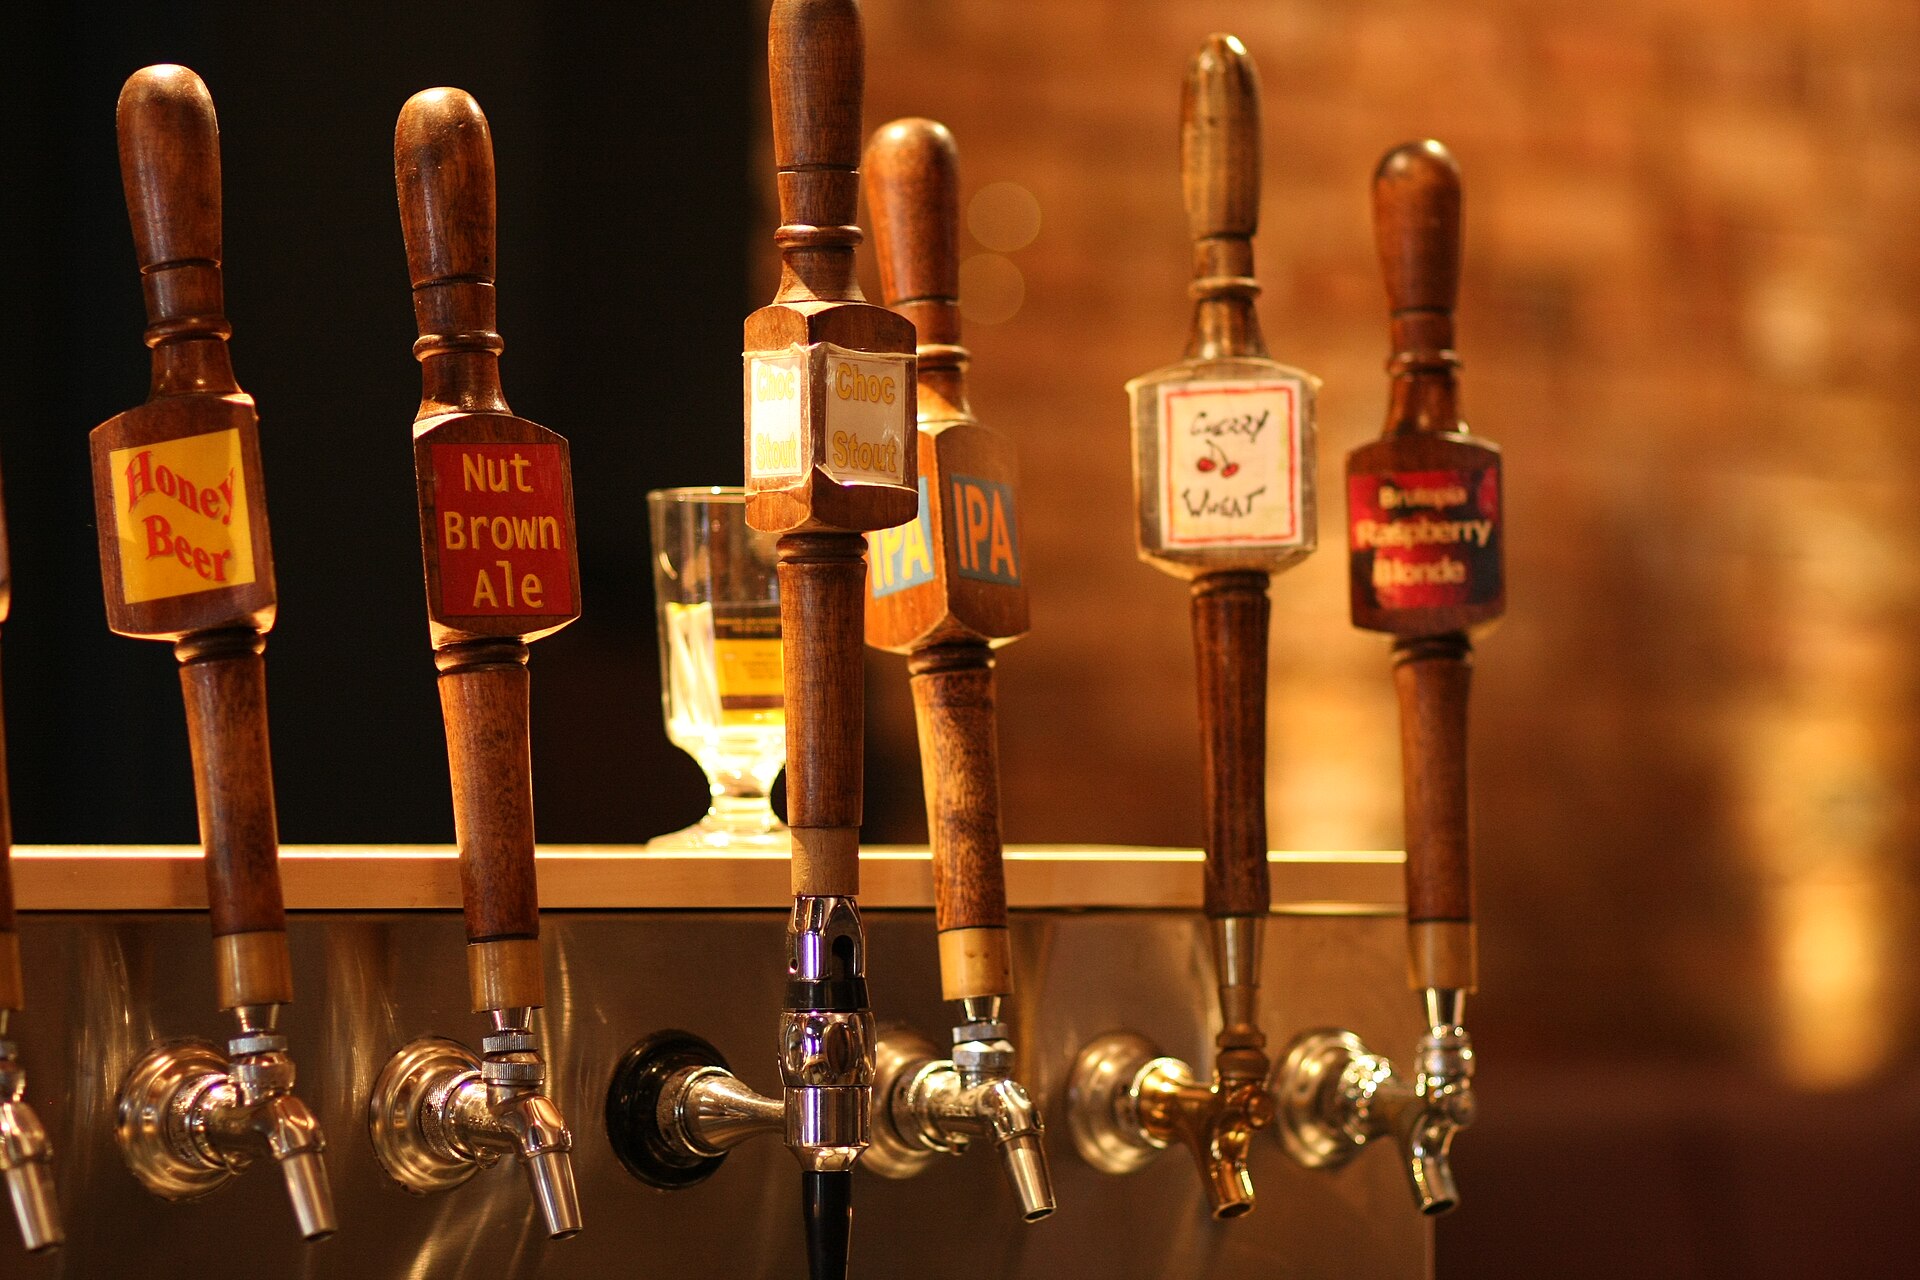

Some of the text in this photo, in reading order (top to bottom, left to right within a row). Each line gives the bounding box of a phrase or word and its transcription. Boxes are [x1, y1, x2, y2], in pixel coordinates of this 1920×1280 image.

[756, 364, 795, 403] Choc
[835, 362, 896, 405] Choc
[755, 432, 798, 470] Stout
[832, 430, 897, 473] Stout
[124, 450, 236, 526] Honey
[462, 452, 534, 494] Nut
[142, 514, 232, 583] Beer
[443, 511, 561, 551] Brown
[953, 481, 1018, 580] IPA
[472, 560, 545, 609] Ale
